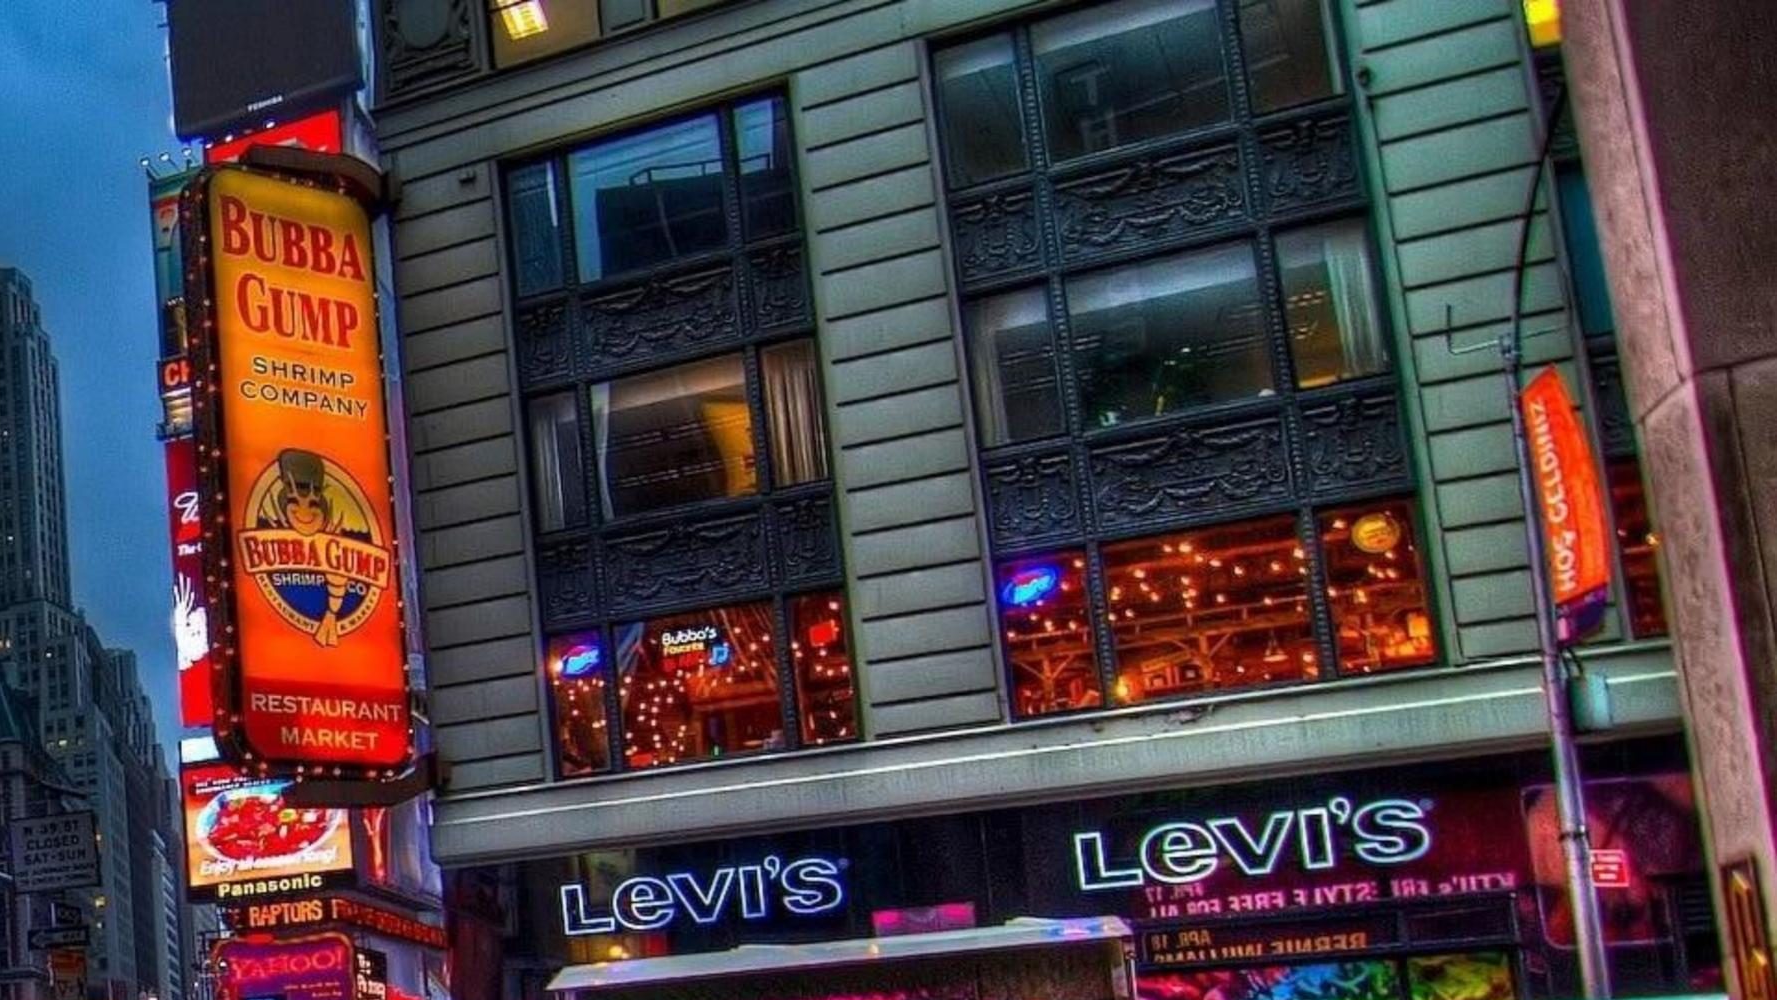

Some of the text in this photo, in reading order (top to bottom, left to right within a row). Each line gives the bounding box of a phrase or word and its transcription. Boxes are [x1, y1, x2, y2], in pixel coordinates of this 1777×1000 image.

[219, 194, 365, 282] BUBBA
[236, 272, 359, 349] GUMP
[253, 356, 355, 389] SHRIMP
[240, 381, 368, 419] COMPANY
[244, 536, 386, 582] BUBBA GUMP
[273, 573, 325, 586] SHRIMP
[251, 692, 402, 722] RESTAURANT
[281, 726, 379, 750] MARKET
[27, 835, 80, 852] CLOSED
[218, 873, 323, 898] Panasonic
[249, 900, 323, 927] RAPTORS
[230, 948, 344, 981] YAHOO!
